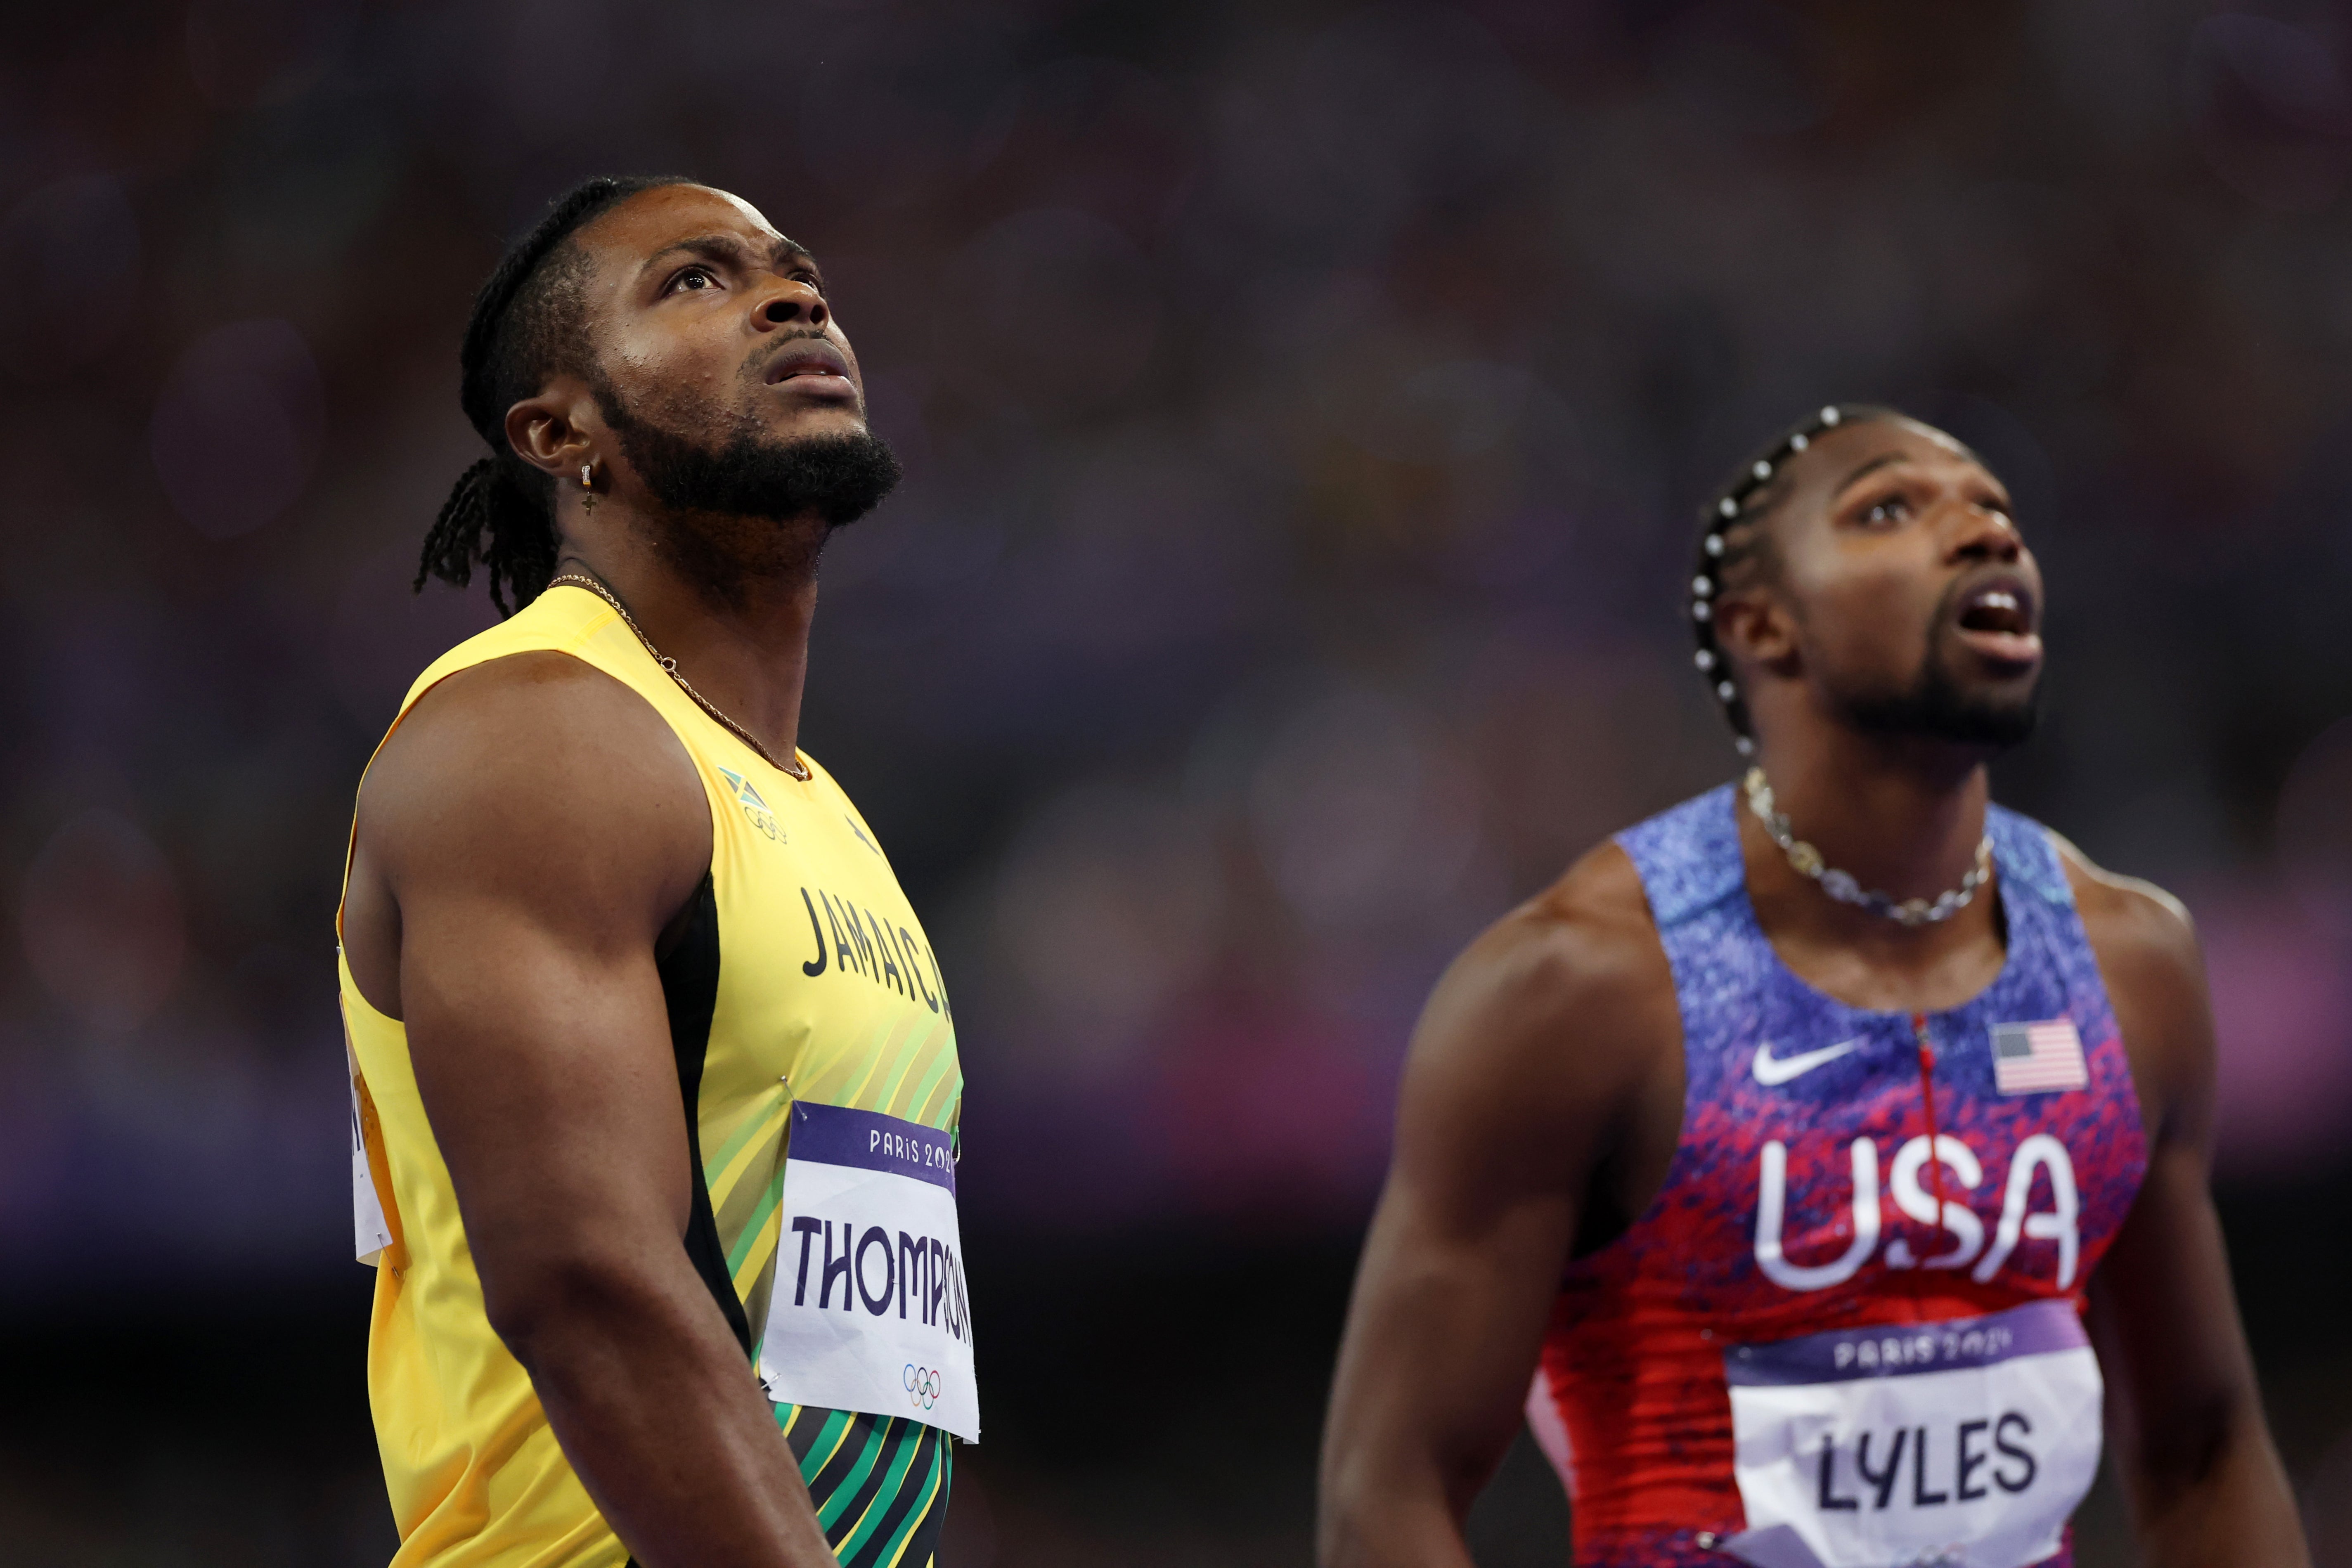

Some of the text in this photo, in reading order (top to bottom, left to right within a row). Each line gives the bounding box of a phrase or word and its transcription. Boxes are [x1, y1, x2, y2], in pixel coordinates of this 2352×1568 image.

[925, 1143, 951, 1174] 202
[1754, 1133, 2079, 1291] USA
[792, 1216, 971, 1348] THOMPSON
[1820, 1412, 2037, 1512] LYLES
